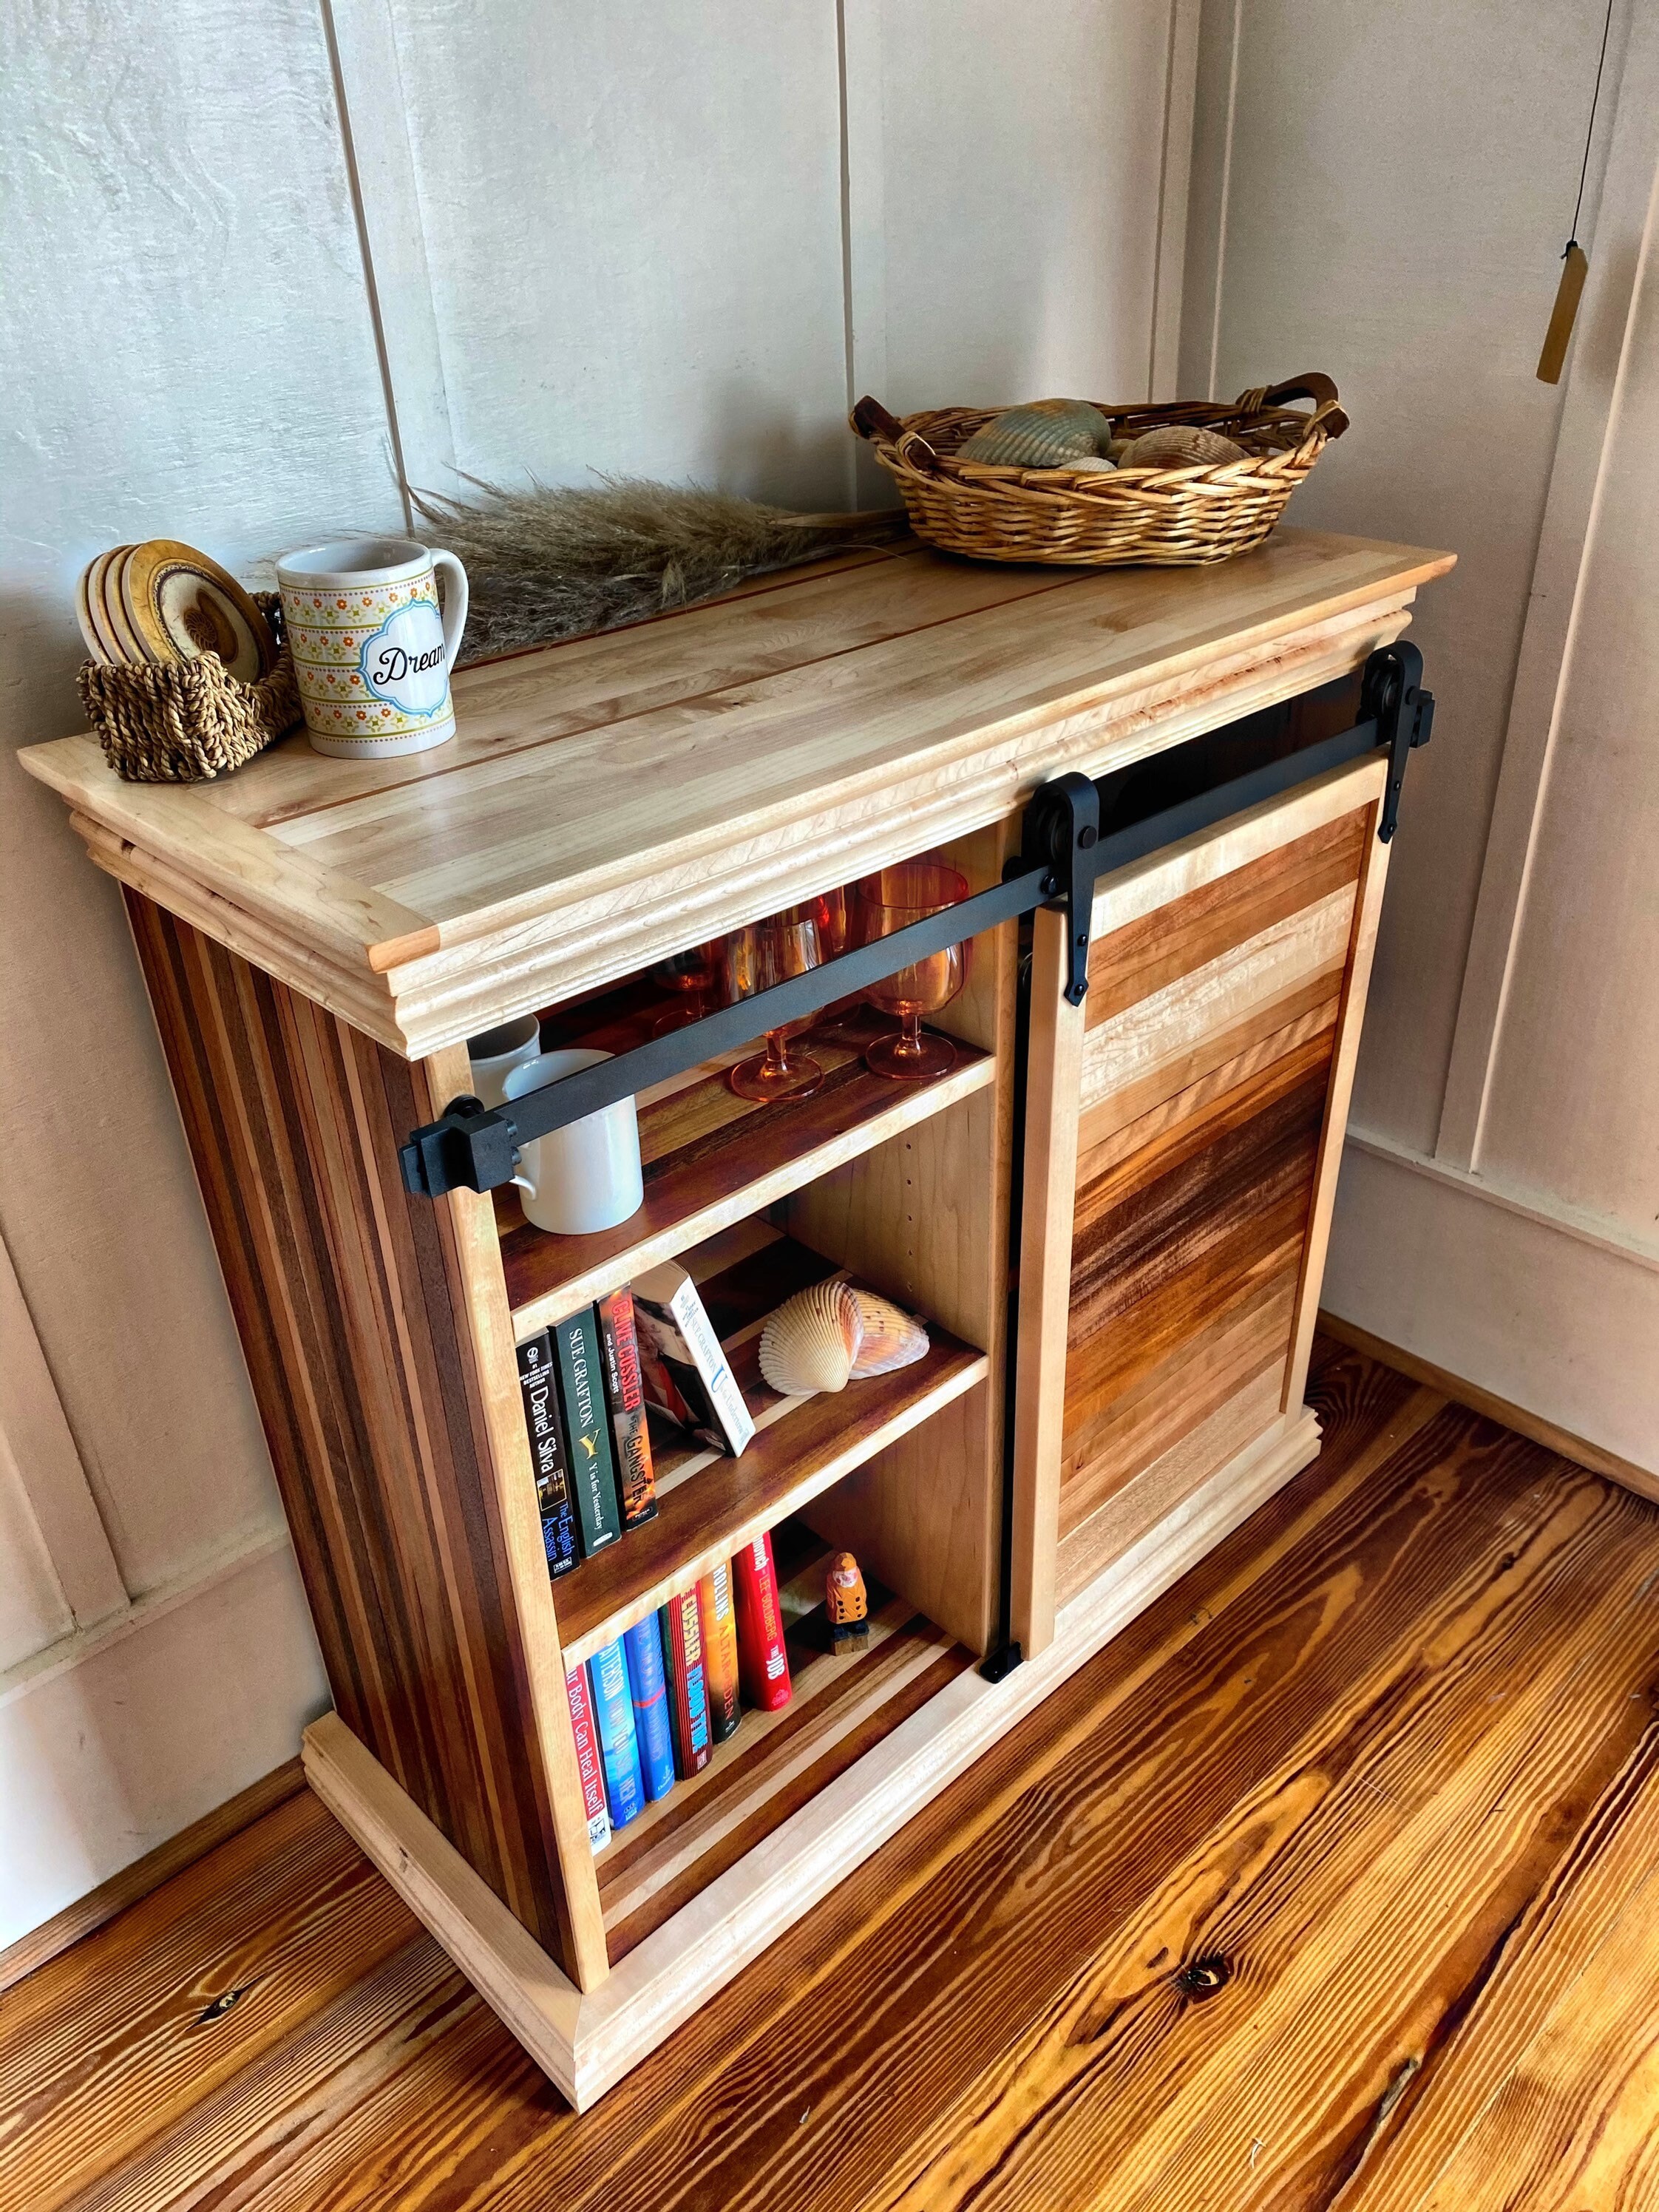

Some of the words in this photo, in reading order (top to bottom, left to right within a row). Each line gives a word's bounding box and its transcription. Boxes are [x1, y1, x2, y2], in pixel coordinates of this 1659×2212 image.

[373, 642, 445, 685] Dream
[612, 1300, 634, 1346] CLIVE
[569, 1328, 586, 1360] SUE
[608, 1346, 618, 1372] Justin
[691, 1317, 702, 1337] SUE
[697, 1333, 717, 1373] GRAFTON
[529, 1377, 546, 1389] AUTHOR
[540, 1361, 553, 1371] TIMES
[611, 1371, 620, 1394] Scott
[617, 1346, 641, 1412] CUSSLER
[711, 1364, 728, 1393] U
[530, 1385, 554, 1438] Daniel
[573, 1359, 594, 1428] GRAFTON
[578, 1428, 602, 1460] Y
[628, 1419, 638, 1436] THE
[537, 1436, 557, 1473] Silva
[588, 1462, 598, 1471] Y
[627, 1435, 648, 1506] GANGSTER
[589, 1470, 599, 1480] is
[591, 1478, 600, 1494] for
[559, 1501, 569, 1519] The
[592, 1491, 605, 1530] Yesterday
[542, 1516, 560, 1562] Assassin
[556, 1514, 575, 1558] English
[713, 1563, 729, 1621] ROLLINS
[759, 1574, 771, 1594] LEE
[681, 1594, 702, 1667] CUSSLER
[761, 1592, 778, 1641] GOLDBERG
[719, 1625, 732, 1672] ALTAR
[765, 1653, 785, 1680] JOB
[770, 1644, 780, 1659] THE
[598, 1641, 625, 1702] ATTERSON
[569, 1683, 587, 1723] Body
[686, 1662, 705, 1719] FLOOD
[722, 1675, 735, 1721] EDEN
[608, 1699, 627, 1730] NOW
[691, 1710, 708, 1754] TIDE
[575, 1720, 589, 1751] Can
[612, 1725, 632, 1756] YOU
[580, 1747, 597, 1783] Heal
[584, 1777, 605, 1816] Itself
[619, 1774, 637, 1806] HER
